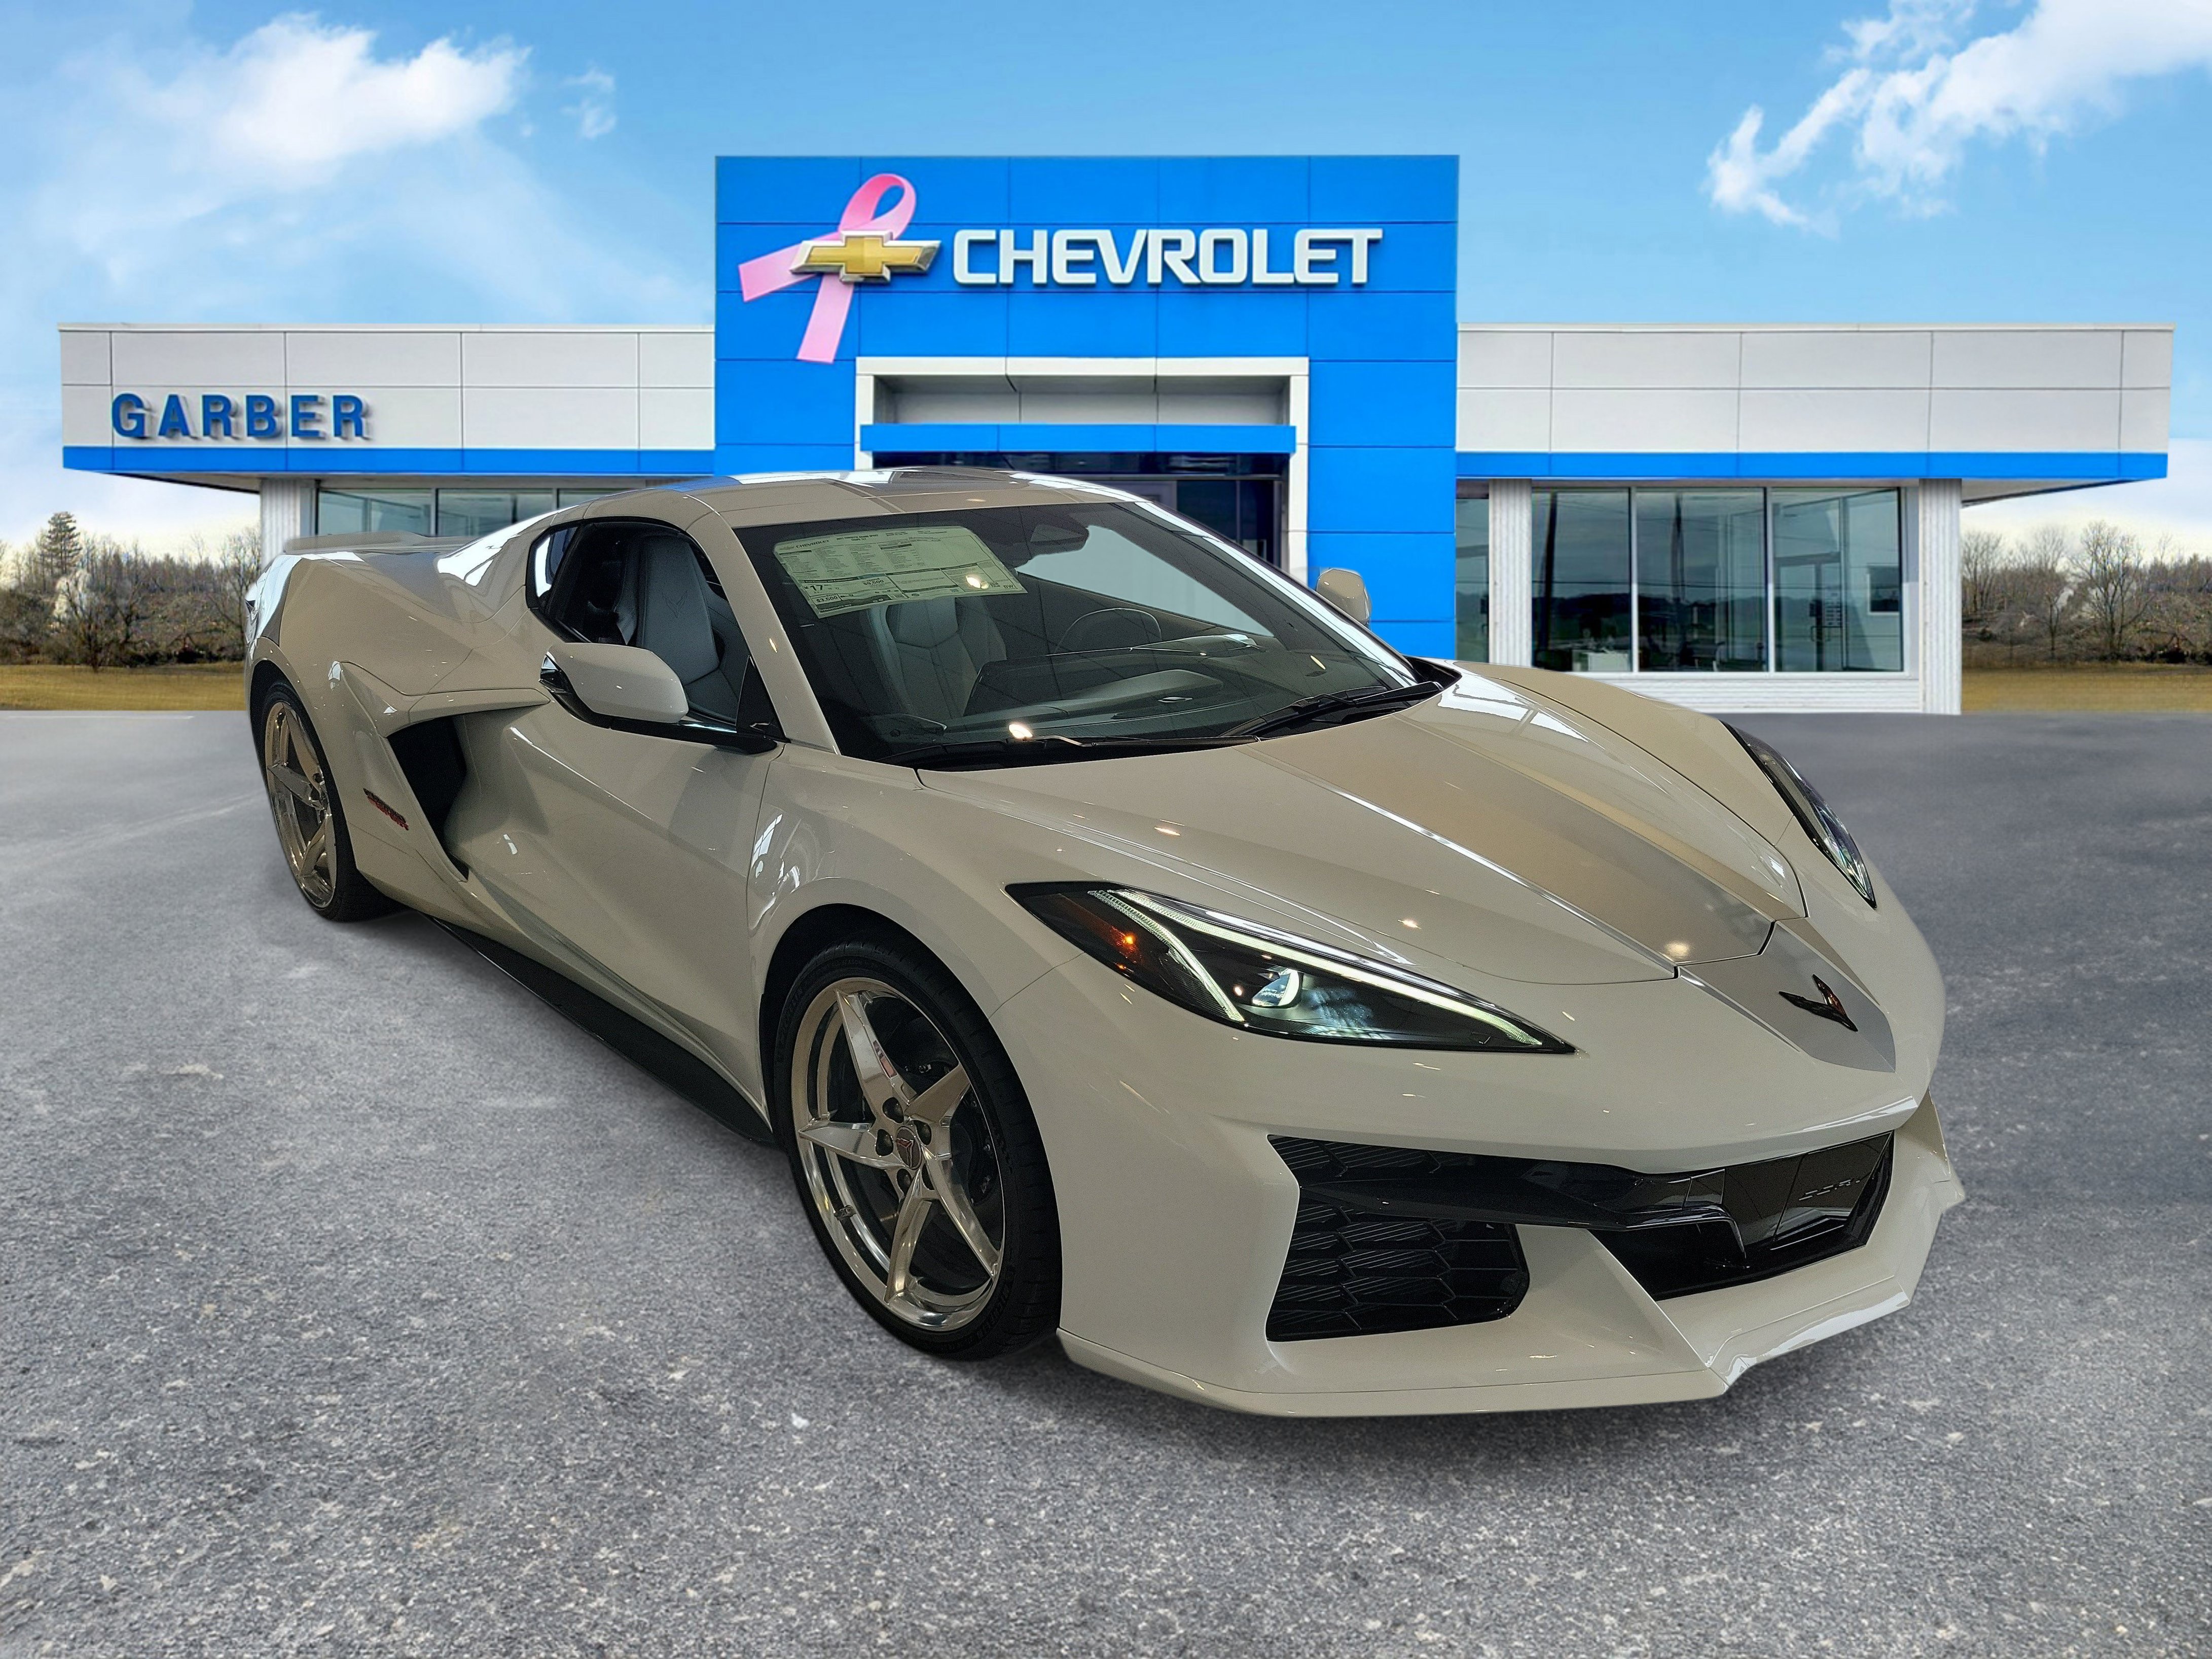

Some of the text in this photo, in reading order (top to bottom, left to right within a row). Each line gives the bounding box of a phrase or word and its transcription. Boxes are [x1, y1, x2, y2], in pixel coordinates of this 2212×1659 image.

[953, 228, 1383, 285] CHEVROLET
[111, 392, 369, 440] GARBER
[795, 539, 829, 548] CHEVROLET
